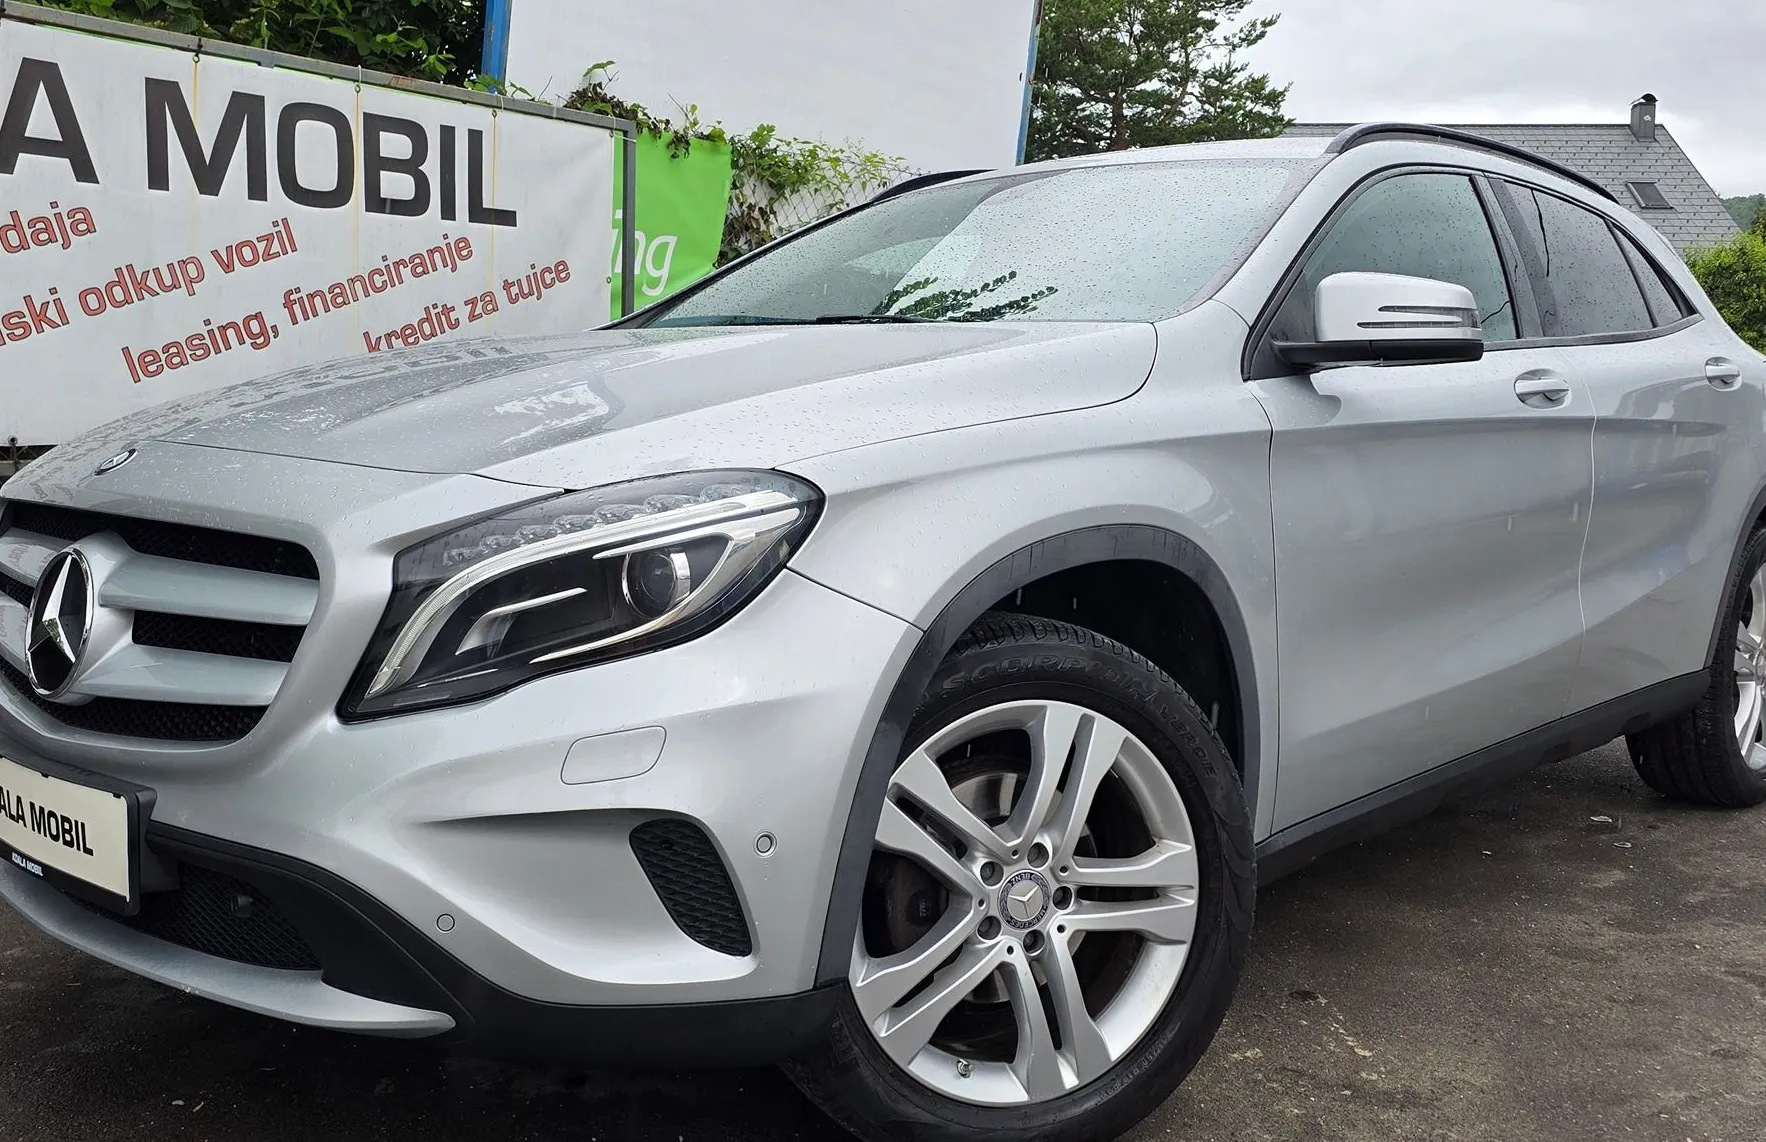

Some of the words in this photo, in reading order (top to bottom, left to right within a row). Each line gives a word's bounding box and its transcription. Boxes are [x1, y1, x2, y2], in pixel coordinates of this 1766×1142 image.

[0, 57, 100, 185] A
[145, 77, 518, 228] MOBIL
[0, 201, 97, 254] daja
[0, 287, 69, 347] ski
[78, 256, 205, 317] odkup
[210, 217, 298, 275] vozil
[121, 311, 279, 384] leasing,
[283, 233, 474, 326] financiranje
[363, 302, 460, 354] kredit
[464, 290, 499, 323] za
[503, 259, 571, 305] tujce
[29, 800, 94, 857] MOBIL
